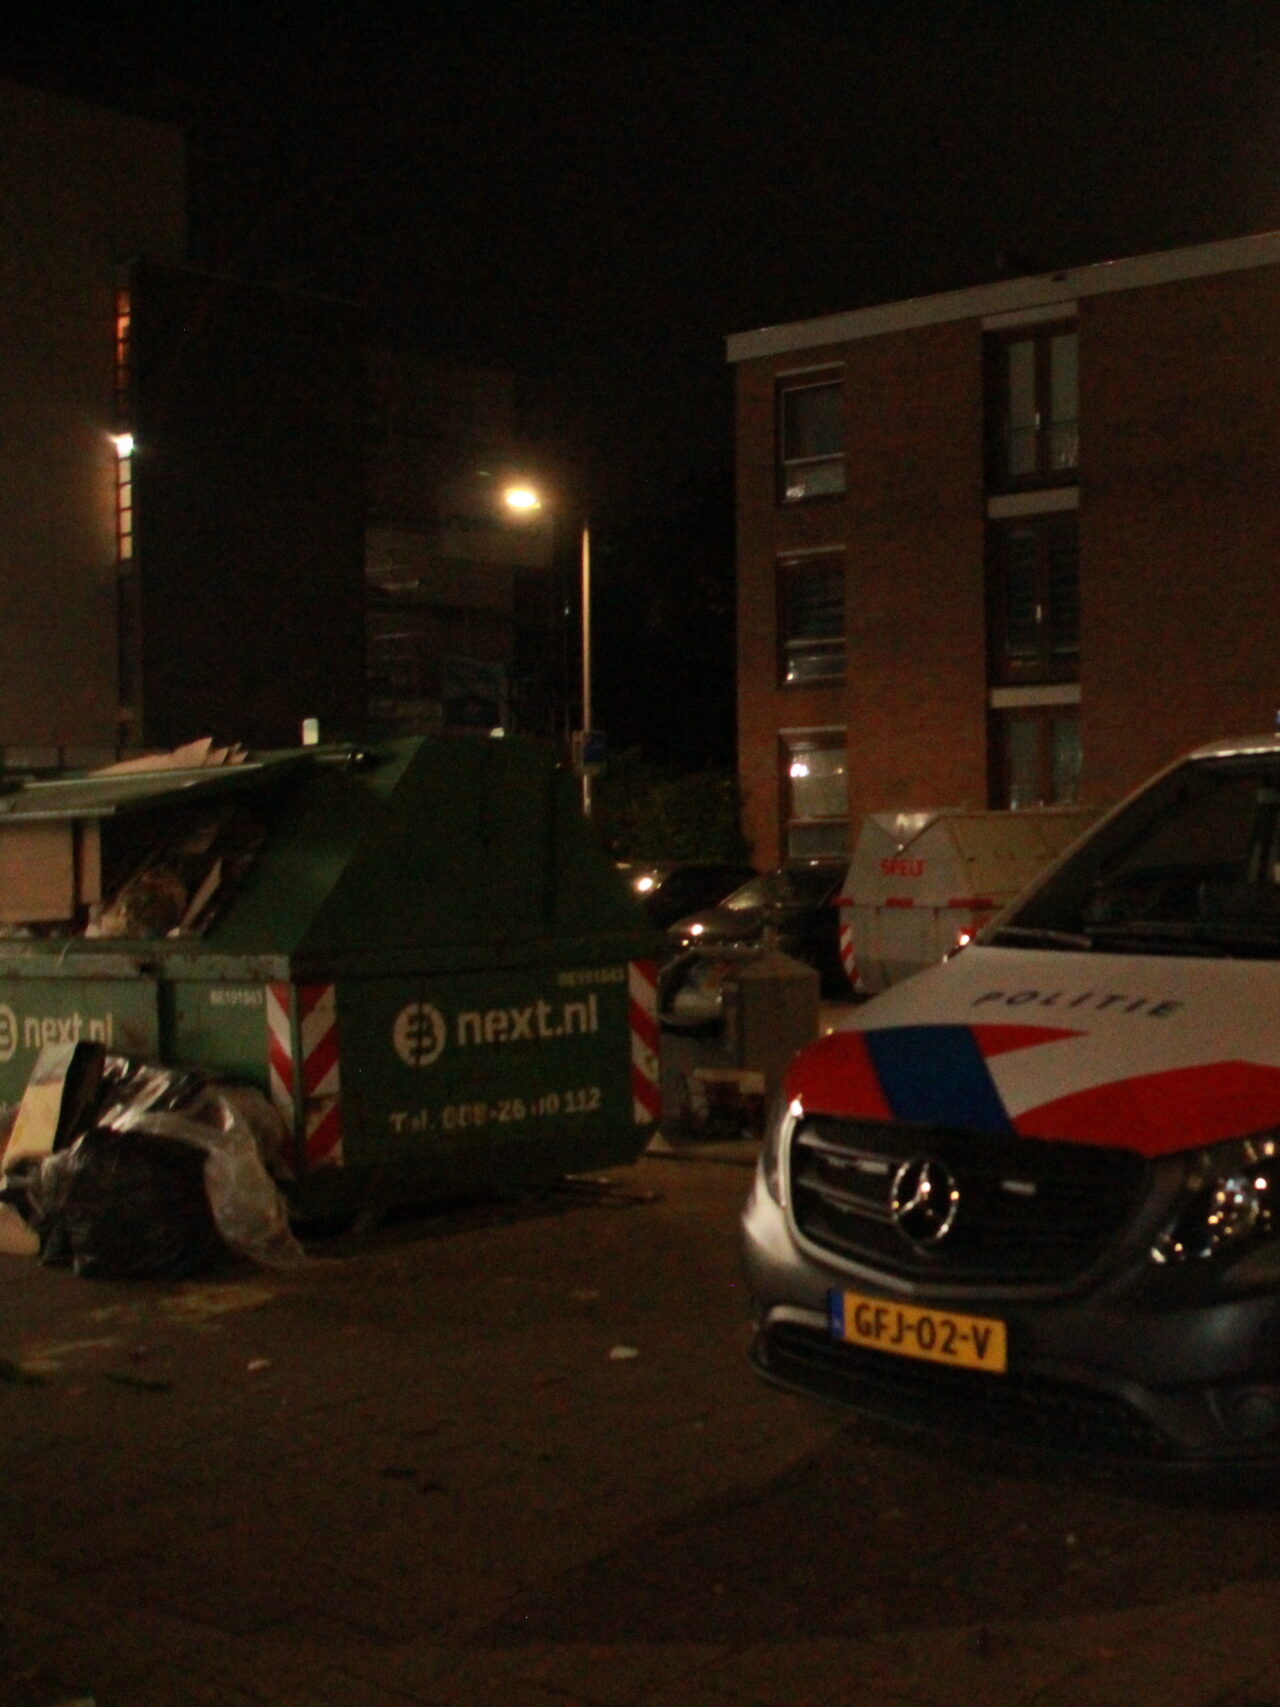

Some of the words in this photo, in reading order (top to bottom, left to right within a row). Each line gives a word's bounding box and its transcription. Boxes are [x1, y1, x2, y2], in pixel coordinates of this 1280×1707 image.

[456, 993, 599, 1047] next.nl
[972, 990, 1183, 1018] POLITIE
[854, 1302, 992, 1360] GFJ-02-V
